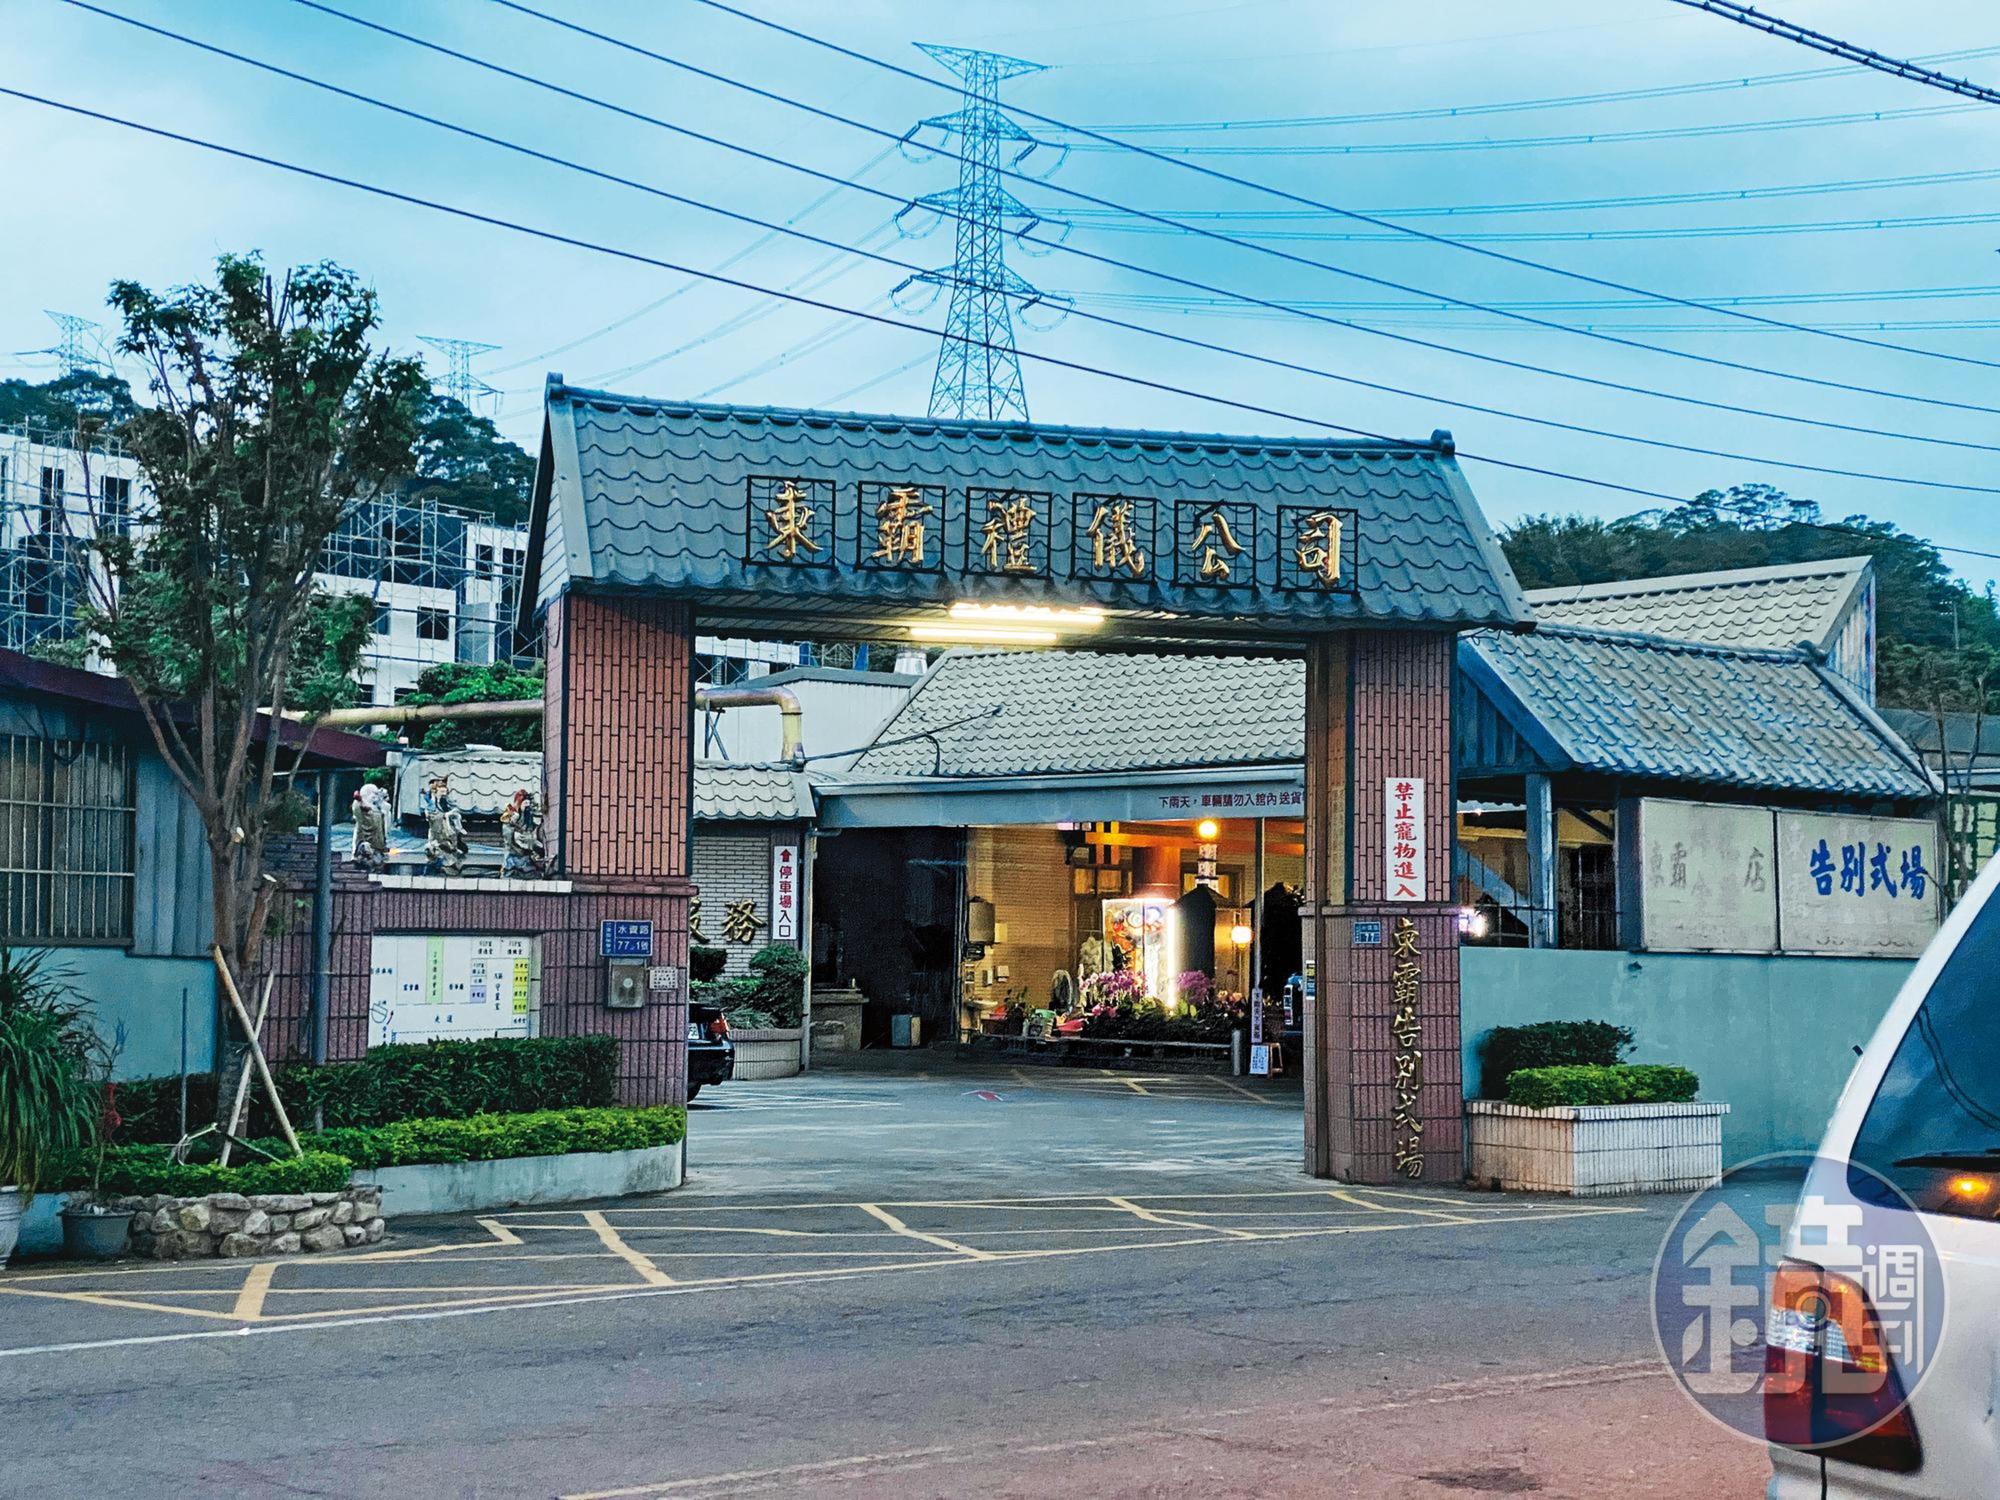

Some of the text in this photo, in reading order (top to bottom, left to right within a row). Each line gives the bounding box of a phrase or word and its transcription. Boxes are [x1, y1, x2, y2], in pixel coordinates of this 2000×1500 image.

[764, 479, 1344, 584] 東霸禮儀公司
[1158, 790, 1305, 809] 下雨天，車輛請勿入館內送貨
[1392, 781, 1418, 899] 禁止寵物進入
[778, 865, 793, 938] 停車場入口
[1809, 838, 1926, 900] 告別式場
[1392, 916, 1425, 1180] 東霸告別式場
